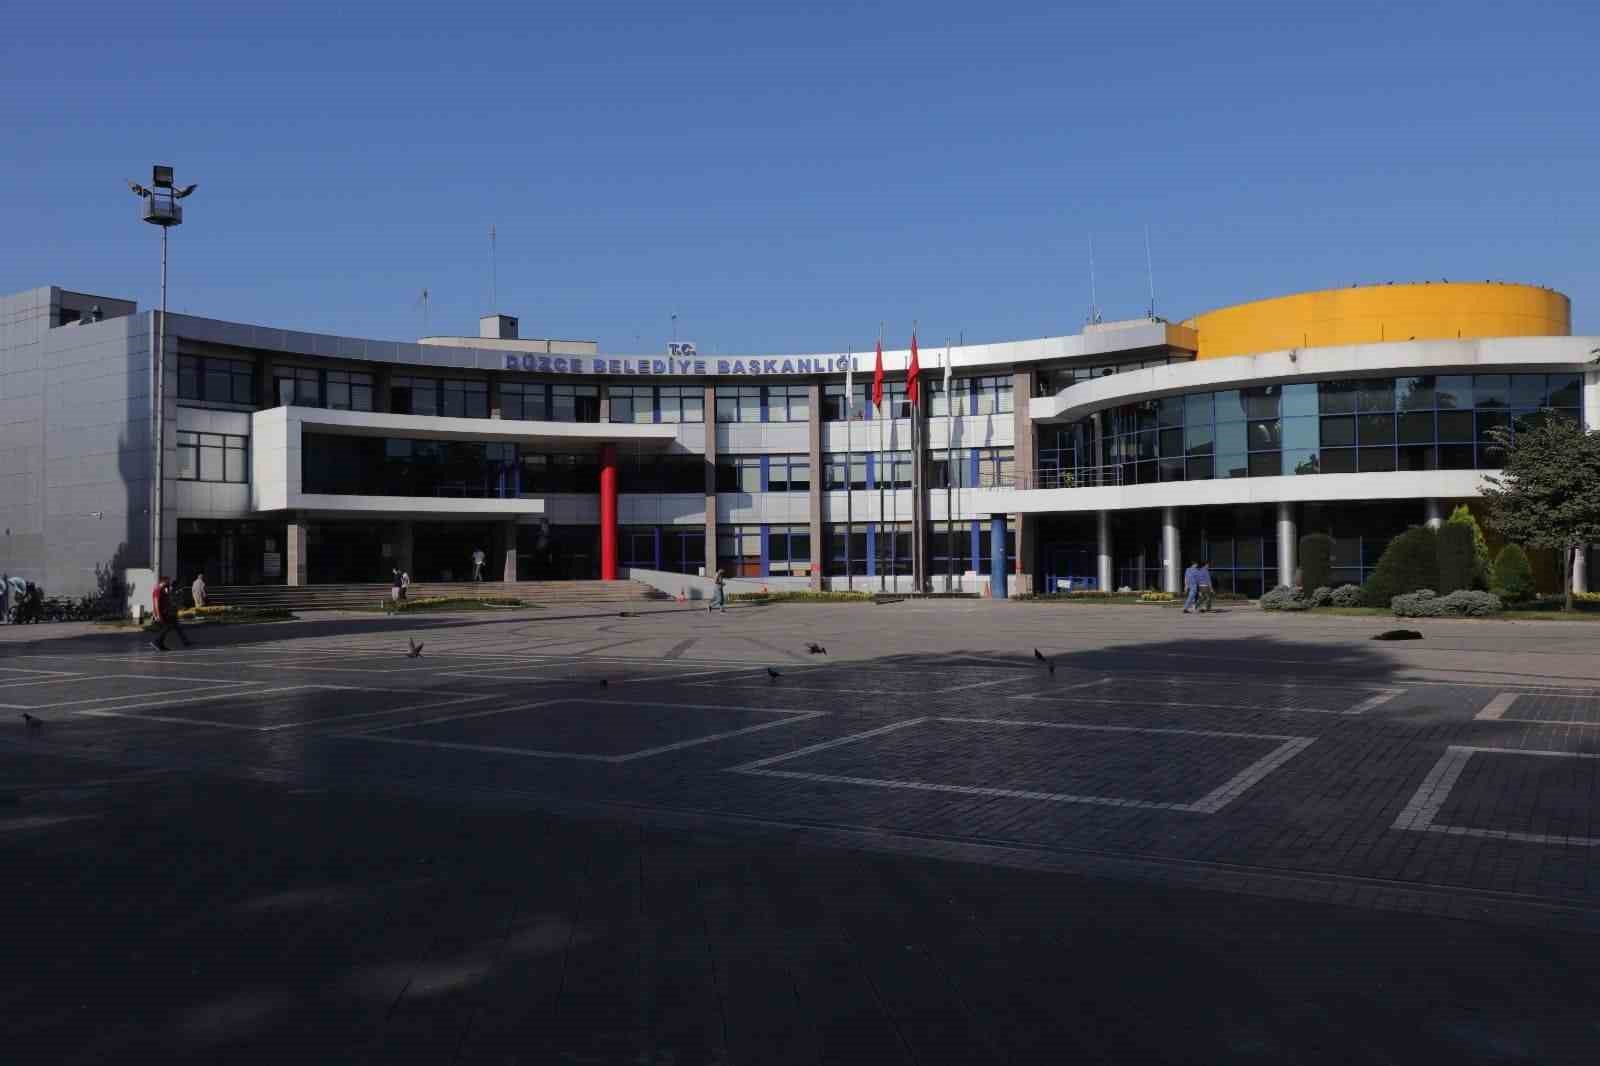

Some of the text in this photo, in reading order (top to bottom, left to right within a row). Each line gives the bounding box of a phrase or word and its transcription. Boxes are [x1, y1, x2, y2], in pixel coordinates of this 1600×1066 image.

[506, 353, 858, 376] DÜZCE BELEDİYE BAŞKANLIĞI
